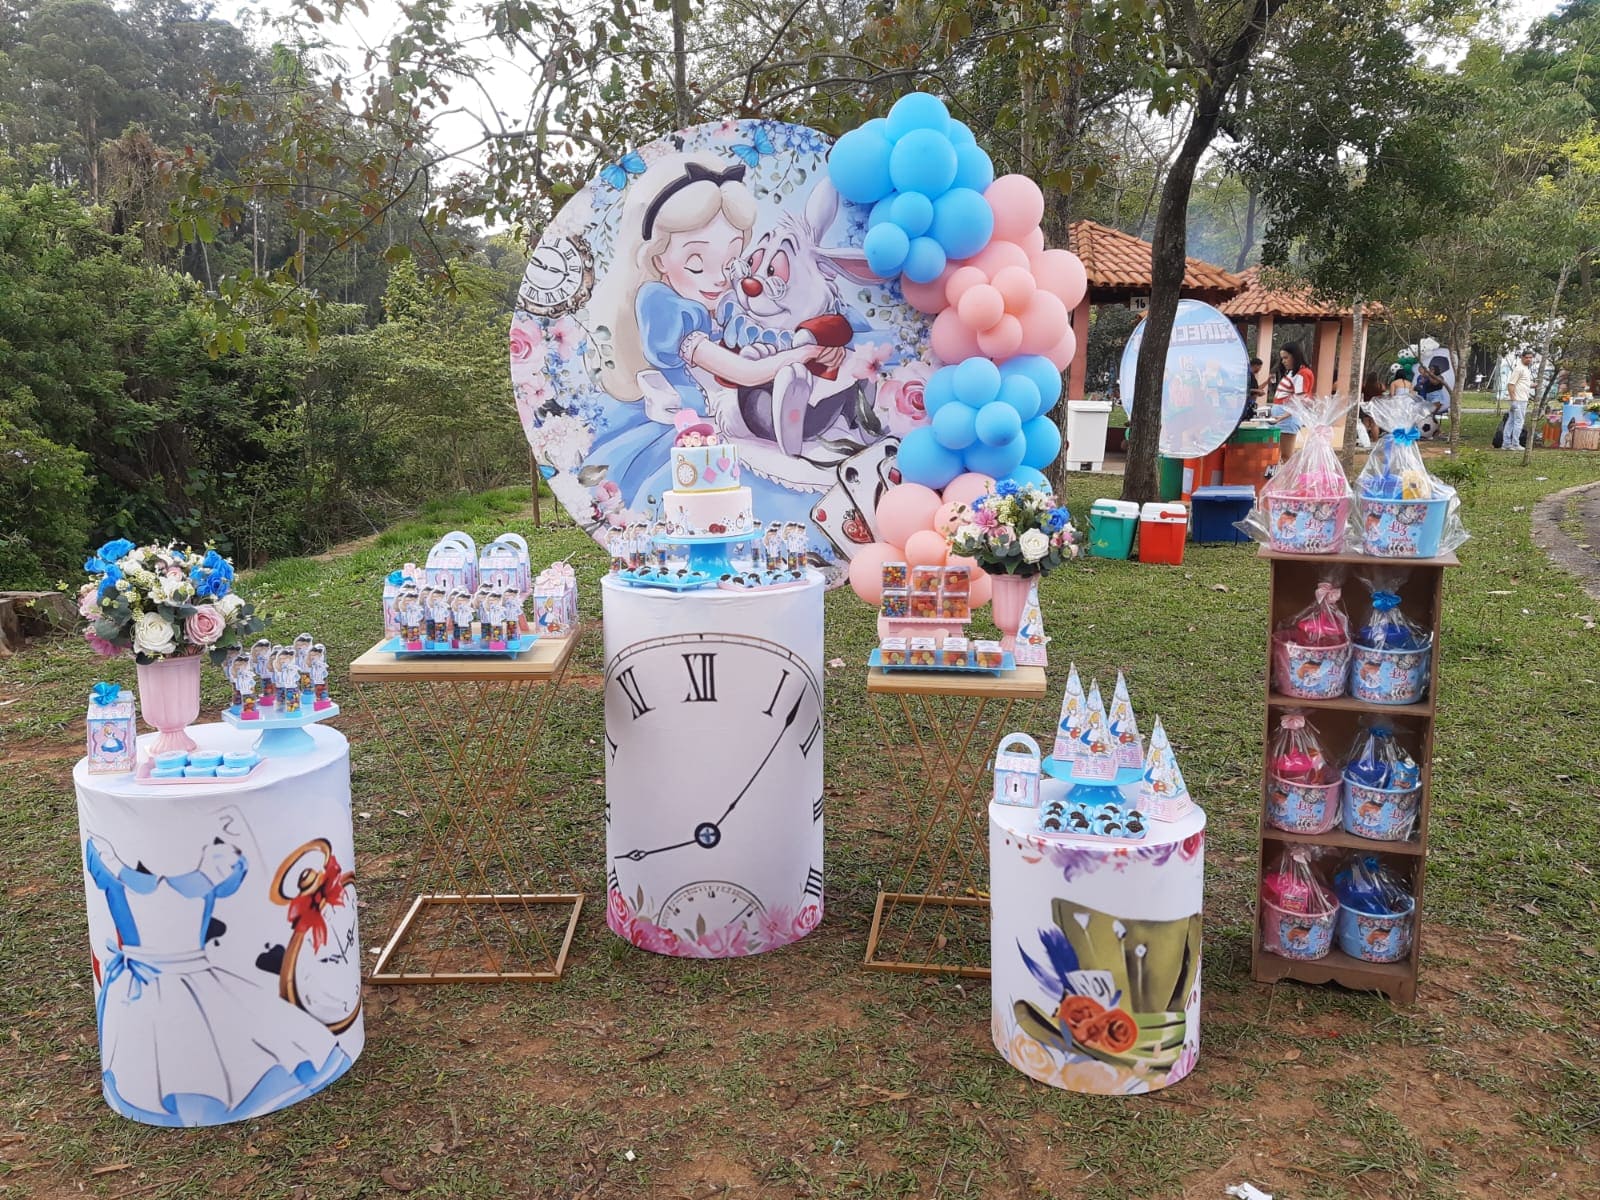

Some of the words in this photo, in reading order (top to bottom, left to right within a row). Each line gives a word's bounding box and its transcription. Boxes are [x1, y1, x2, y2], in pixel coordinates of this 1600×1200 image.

[1135, 299, 1145, 309] 16
[616, 665, 656, 720] XI
[681, 652, 718, 702] XII
